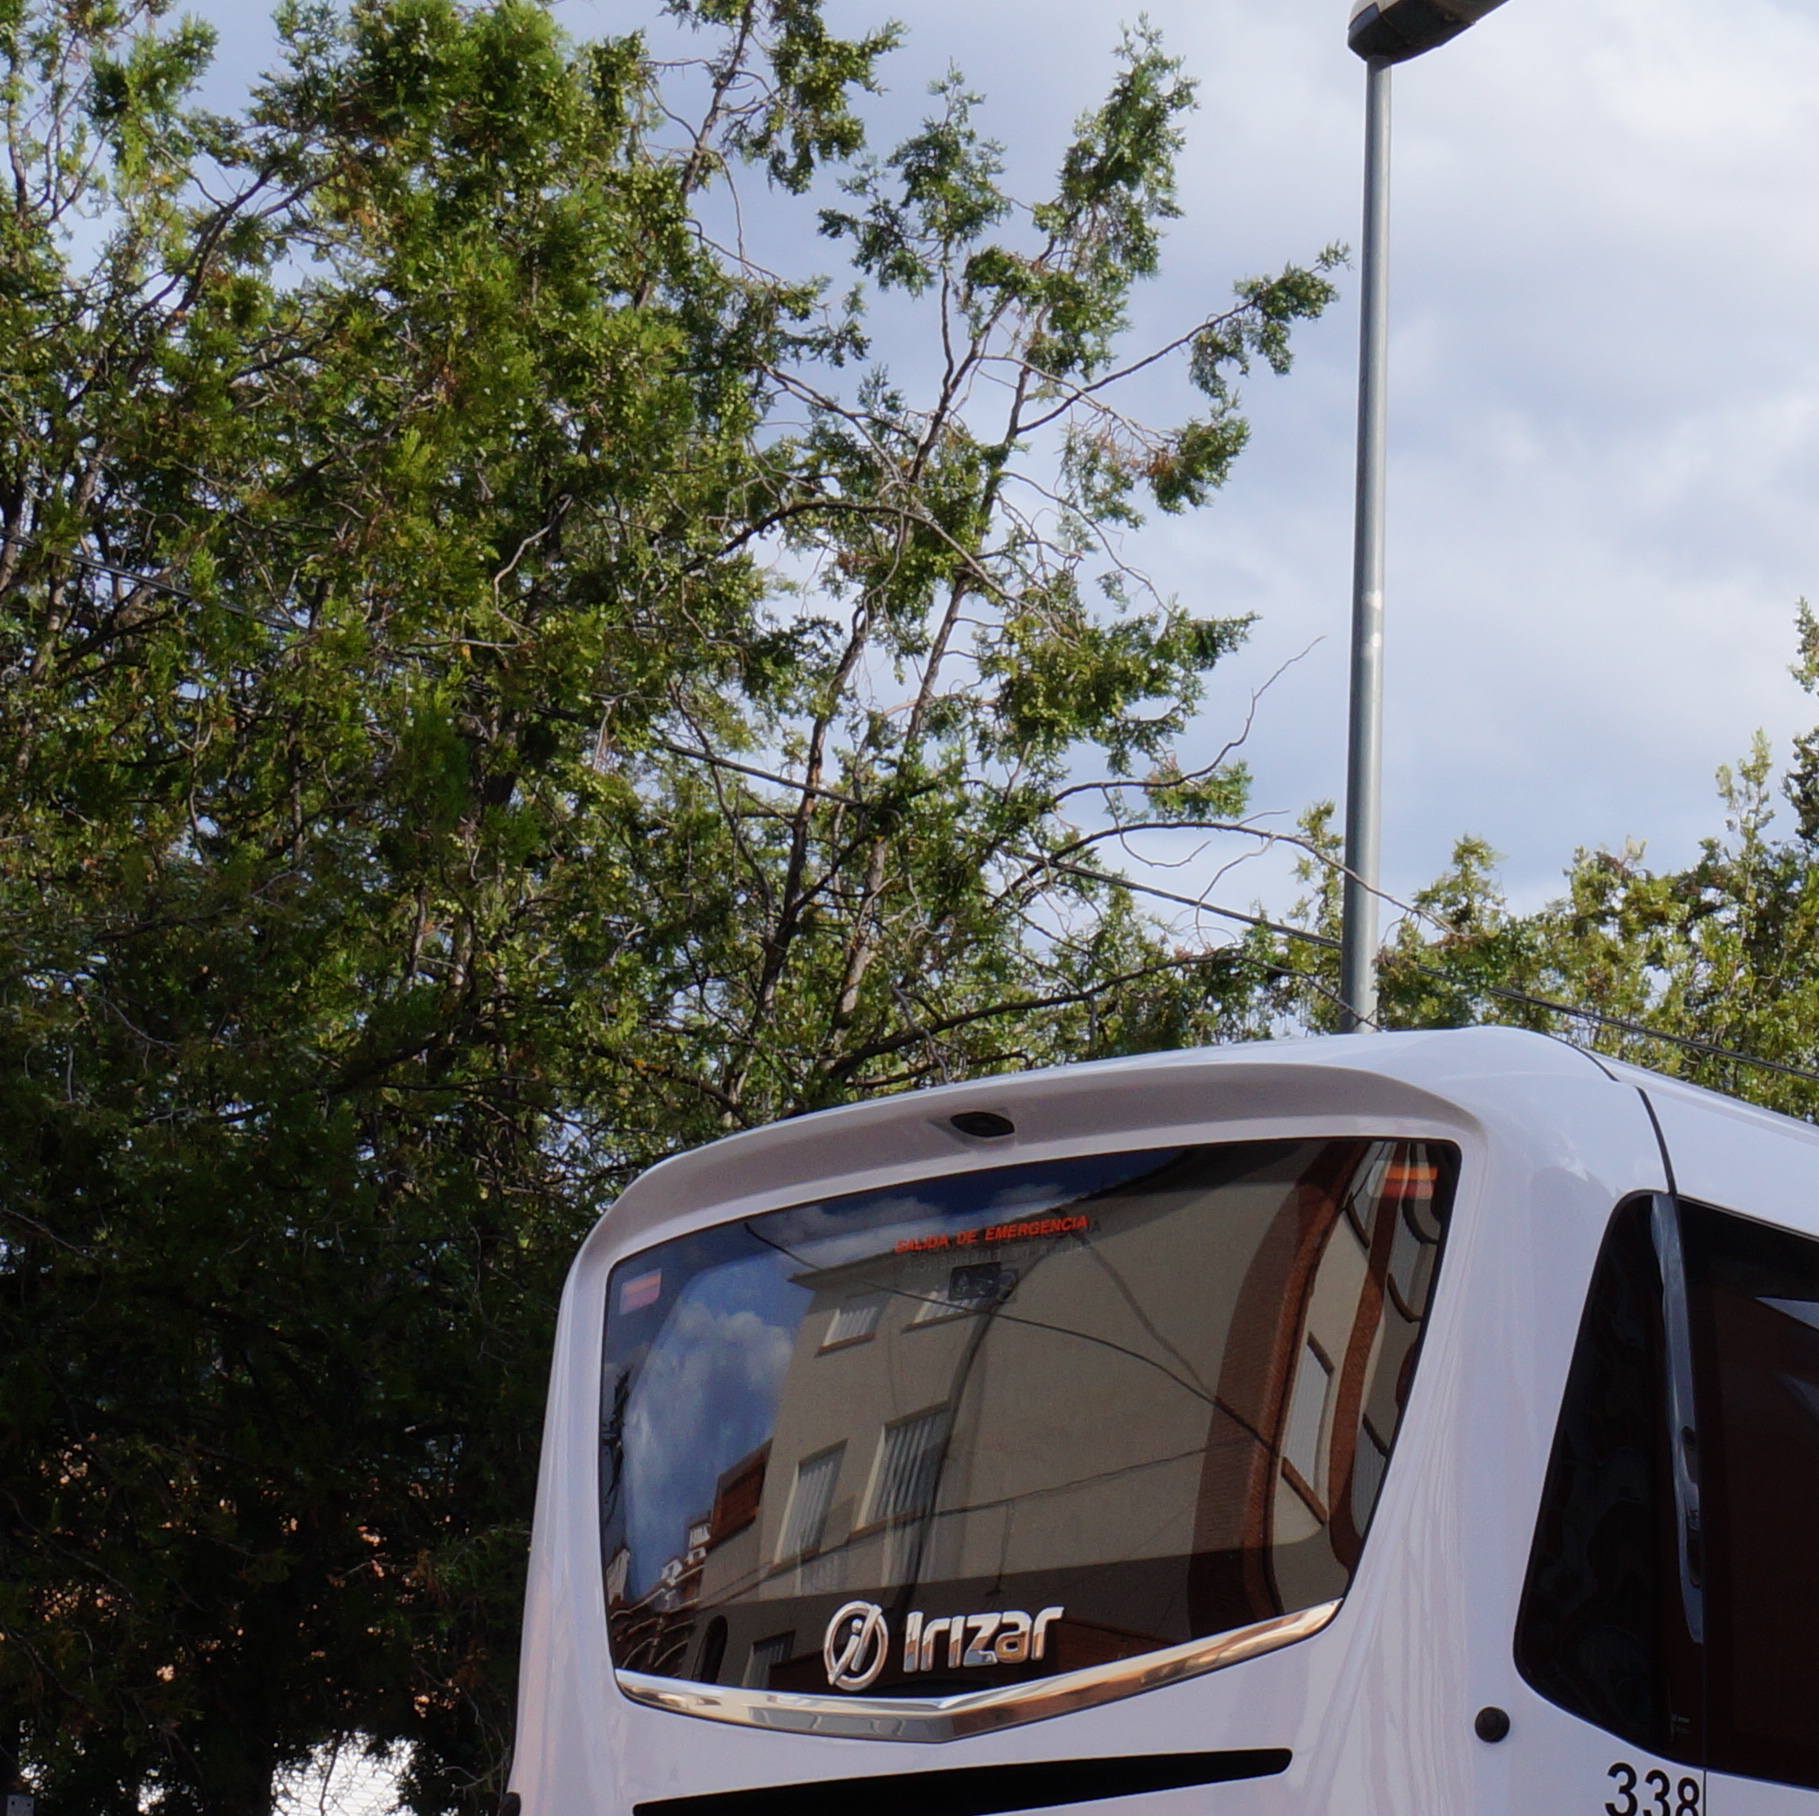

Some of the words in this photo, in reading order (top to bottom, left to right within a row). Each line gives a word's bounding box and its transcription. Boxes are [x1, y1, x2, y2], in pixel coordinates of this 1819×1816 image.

[895, 1234, 950, 1253] SALIDA
[957, 1229, 978, 1245] DE
[985, 1215, 1088, 1241] EMERGENCIA
[903, 1606, 1065, 1673] Irizar
